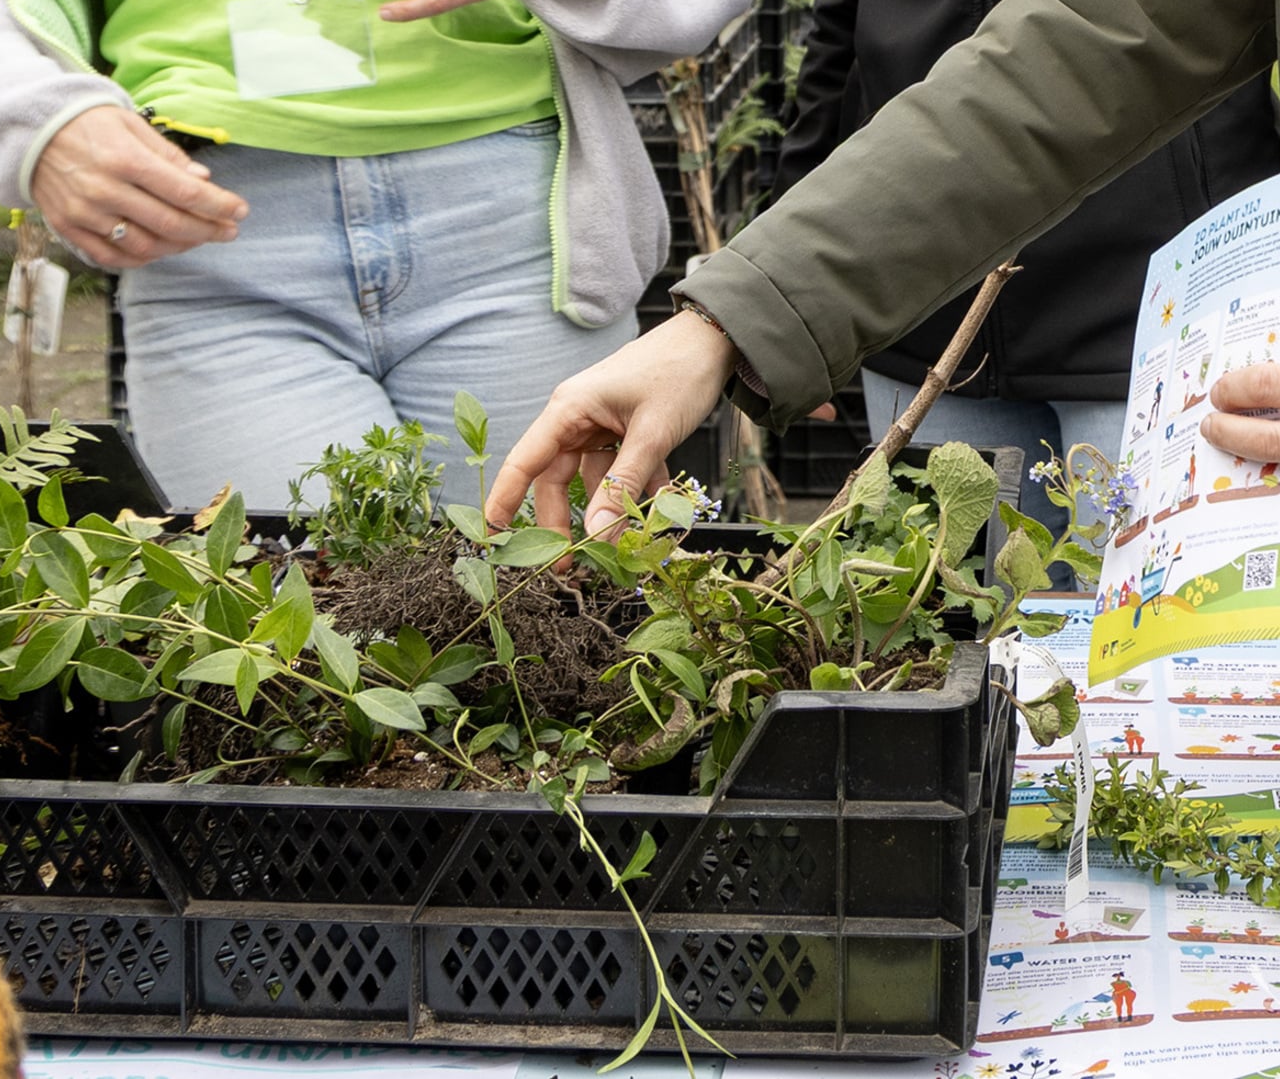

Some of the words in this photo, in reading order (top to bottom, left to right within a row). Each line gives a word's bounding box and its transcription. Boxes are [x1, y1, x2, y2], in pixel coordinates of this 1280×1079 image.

[1208, 208, 1240, 236] PLANT
[1241, 198, 1261, 218] JIJ
[1191, 234, 1223, 265] JOUW
[1027, 957, 1077, 967] WATER
[1082, 953, 1132, 963] GEVEN
[1219, 954, 1268, 963] EXTRA
[1159, 1046, 1181, 1054] van
[1182, 1043, 1216, 1052] jouw
[1218, 1041, 1243, 1049] tuin
[1123, 1058, 1147, 1068] Kijk
[1149, 1056, 1177, 1064] voor
[1181, 1052, 1213, 1060] meer
[1216, 1050, 1239, 1058] tips
[1242, 1048, 1258, 1057] op
